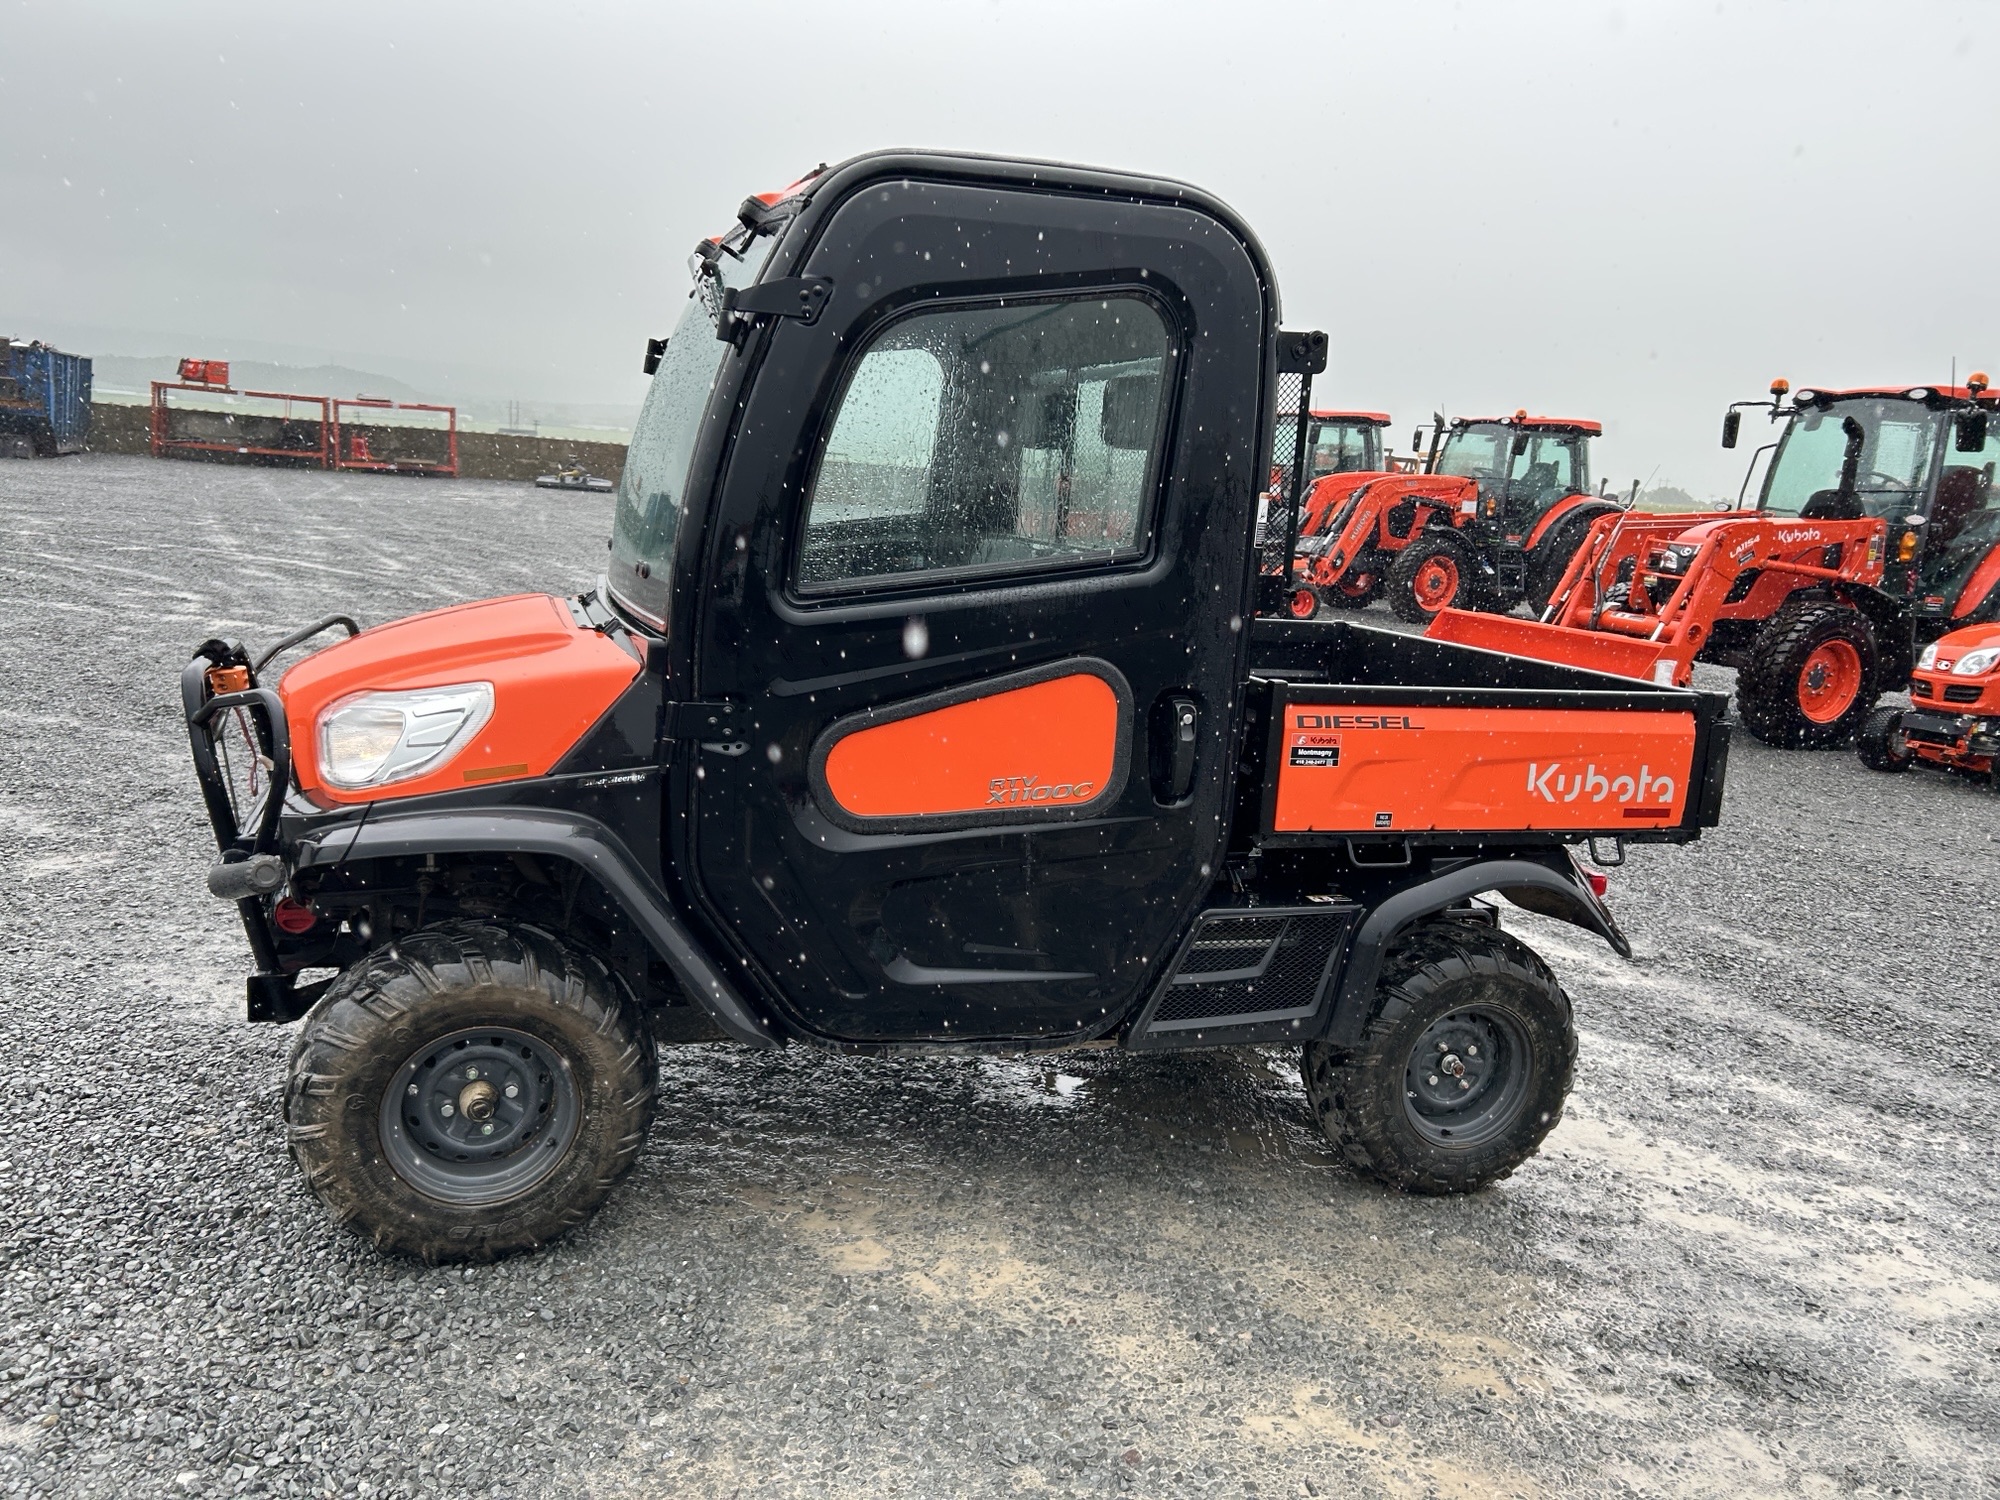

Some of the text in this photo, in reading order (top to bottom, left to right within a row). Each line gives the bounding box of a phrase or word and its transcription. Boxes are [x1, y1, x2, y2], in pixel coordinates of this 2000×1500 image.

[1778, 527, 1821, 543] Kubota
[1729, 534, 1760, 559] LA1154
[1296, 714, 1426, 730] DIESEL
[1310, 737, 1338, 745] Kubota
[1298, 749, 1332, 757] Montmagny
[989, 775, 1039, 790] RTV
[1526, 762, 1675, 803] Kubota
[985, 782, 1094, 805] X1100C
